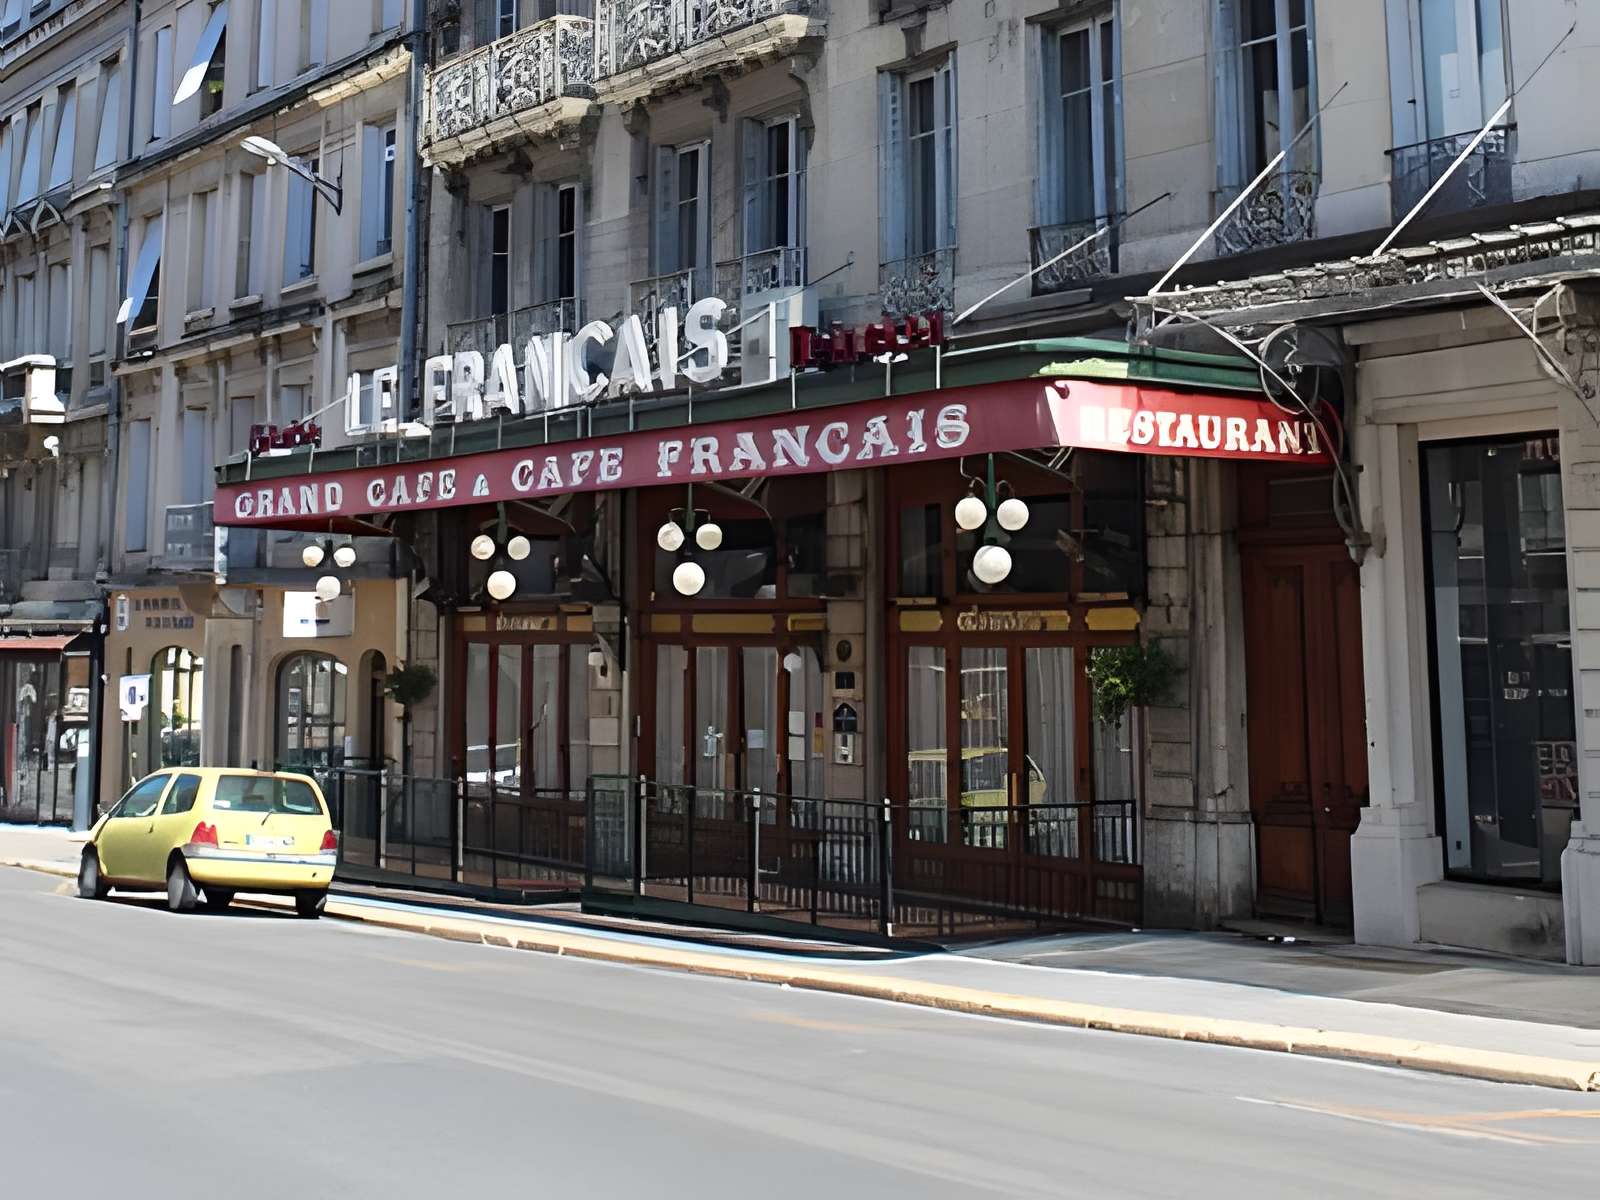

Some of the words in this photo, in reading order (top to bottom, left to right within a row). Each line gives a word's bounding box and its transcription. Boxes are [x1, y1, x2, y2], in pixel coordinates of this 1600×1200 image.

[235, 482, 343, 518] GRAND
[366, 469, 456, 507] CAFE
[511, 447, 624, 492] CAFE
